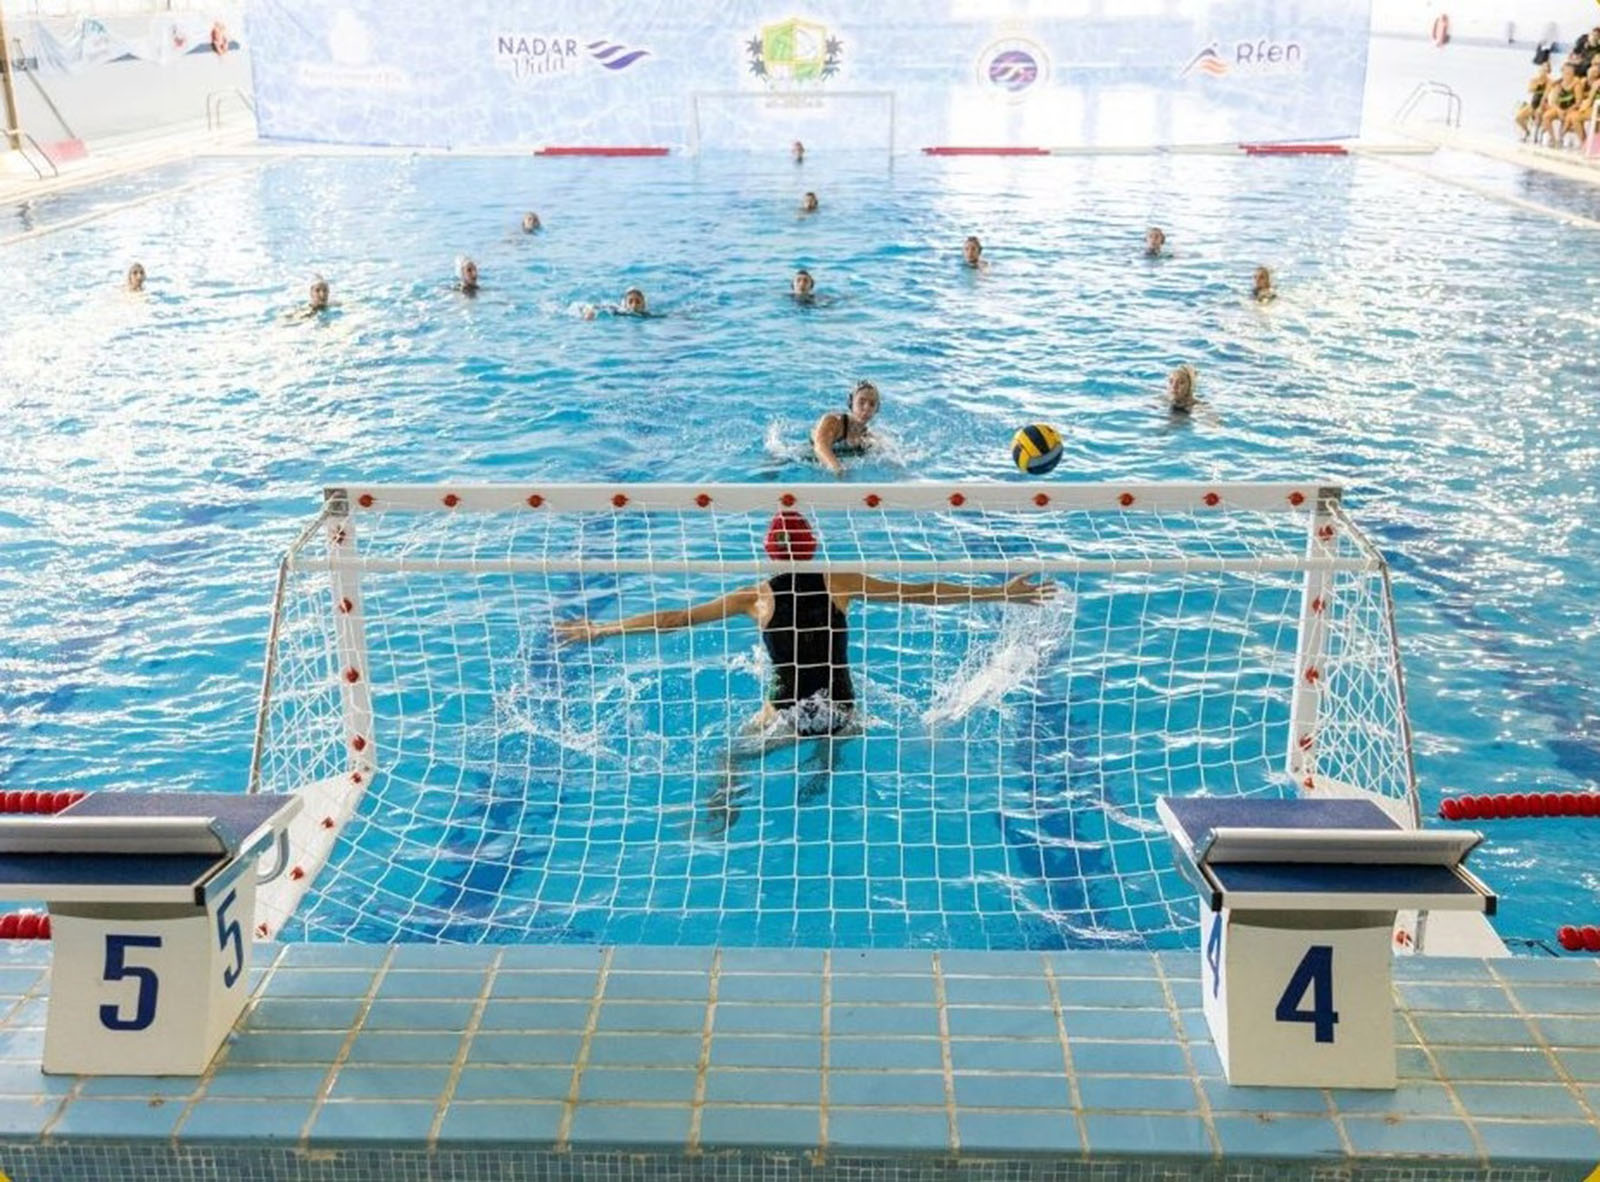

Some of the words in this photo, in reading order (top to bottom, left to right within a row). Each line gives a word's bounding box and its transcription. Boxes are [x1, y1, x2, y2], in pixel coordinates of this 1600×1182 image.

[498, 37, 577, 56] NADAR
[1237, 40, 1300, 62] Rfen
[99, 934, 162, 1030] 5
[217, 889, 243, 988] 5
[1275, 945, 1338, 1043] 4
